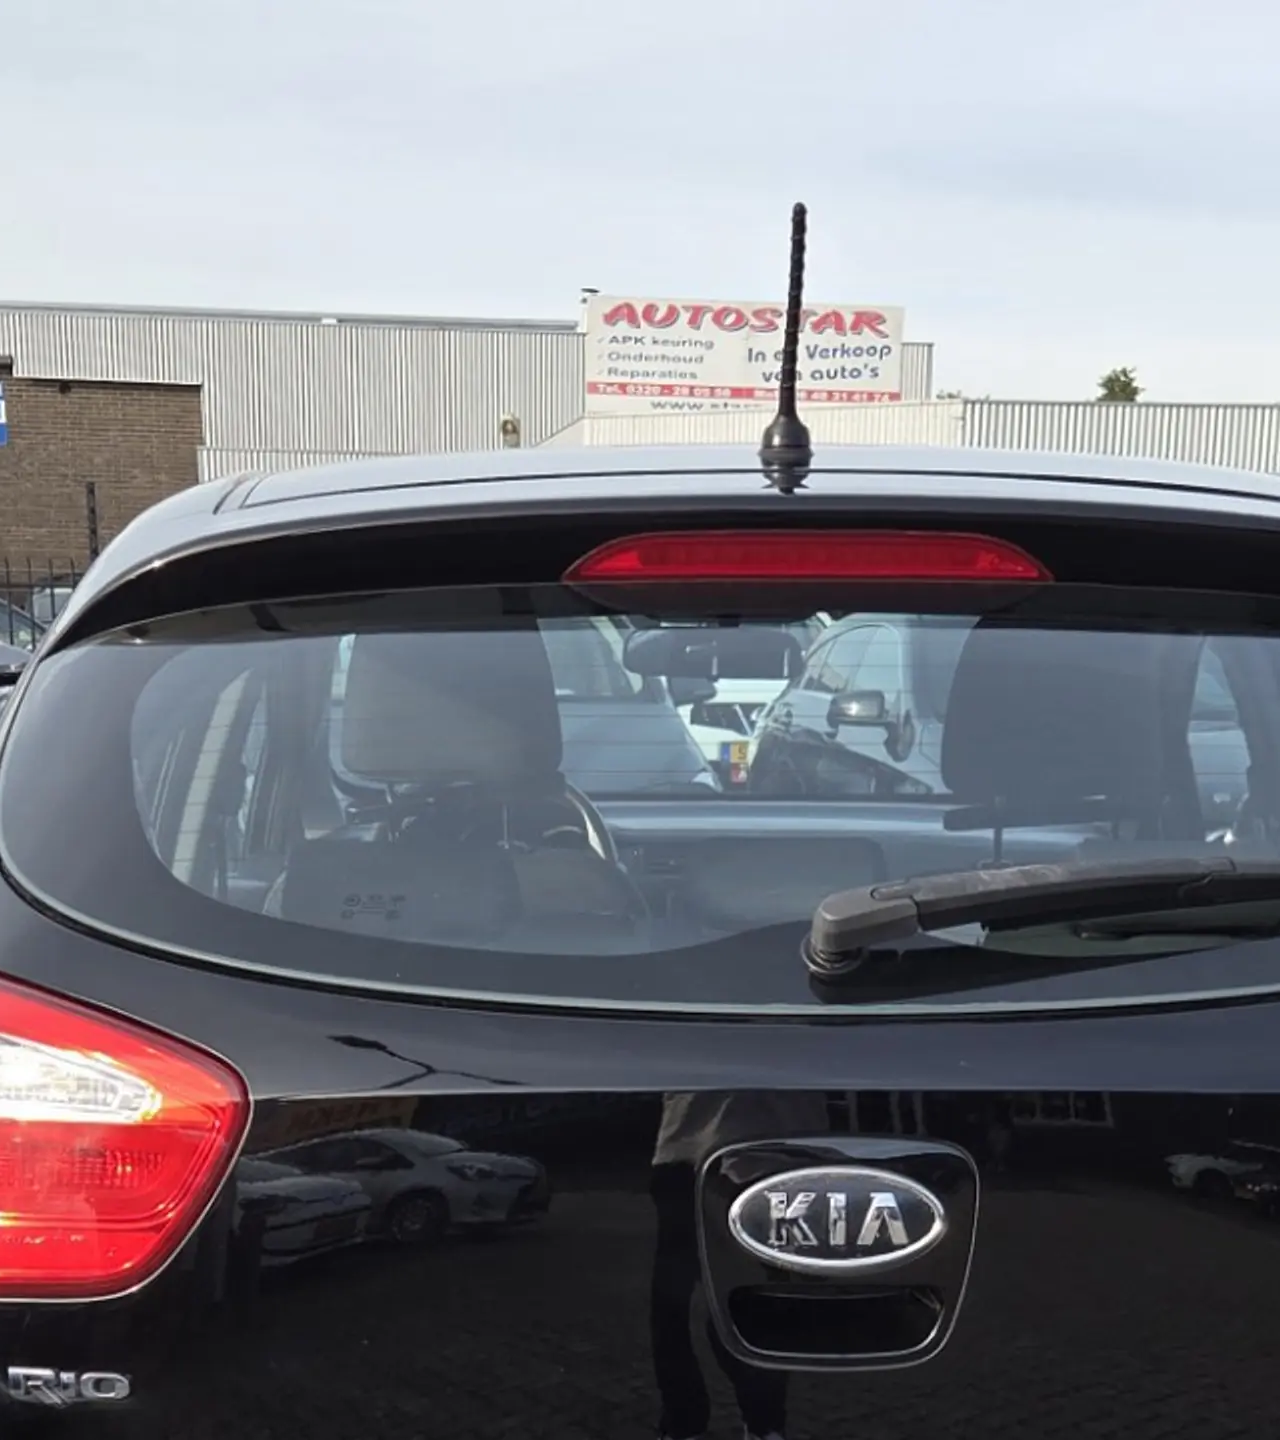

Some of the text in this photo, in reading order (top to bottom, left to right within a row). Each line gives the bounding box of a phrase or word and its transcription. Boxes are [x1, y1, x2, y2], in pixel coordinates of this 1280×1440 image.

[603, 302, 890, 338] AUTOSTAR
[608, 335, 715, 350] APK keuring
[607, 351, 704, 364] Onderhoud
[805, 343, 892, 360] Verkoop
[607, 366, 698, 380] Reparaties
[810, 363, 880, 381] auto's
[764, 1191, 910, 1247] KIA
